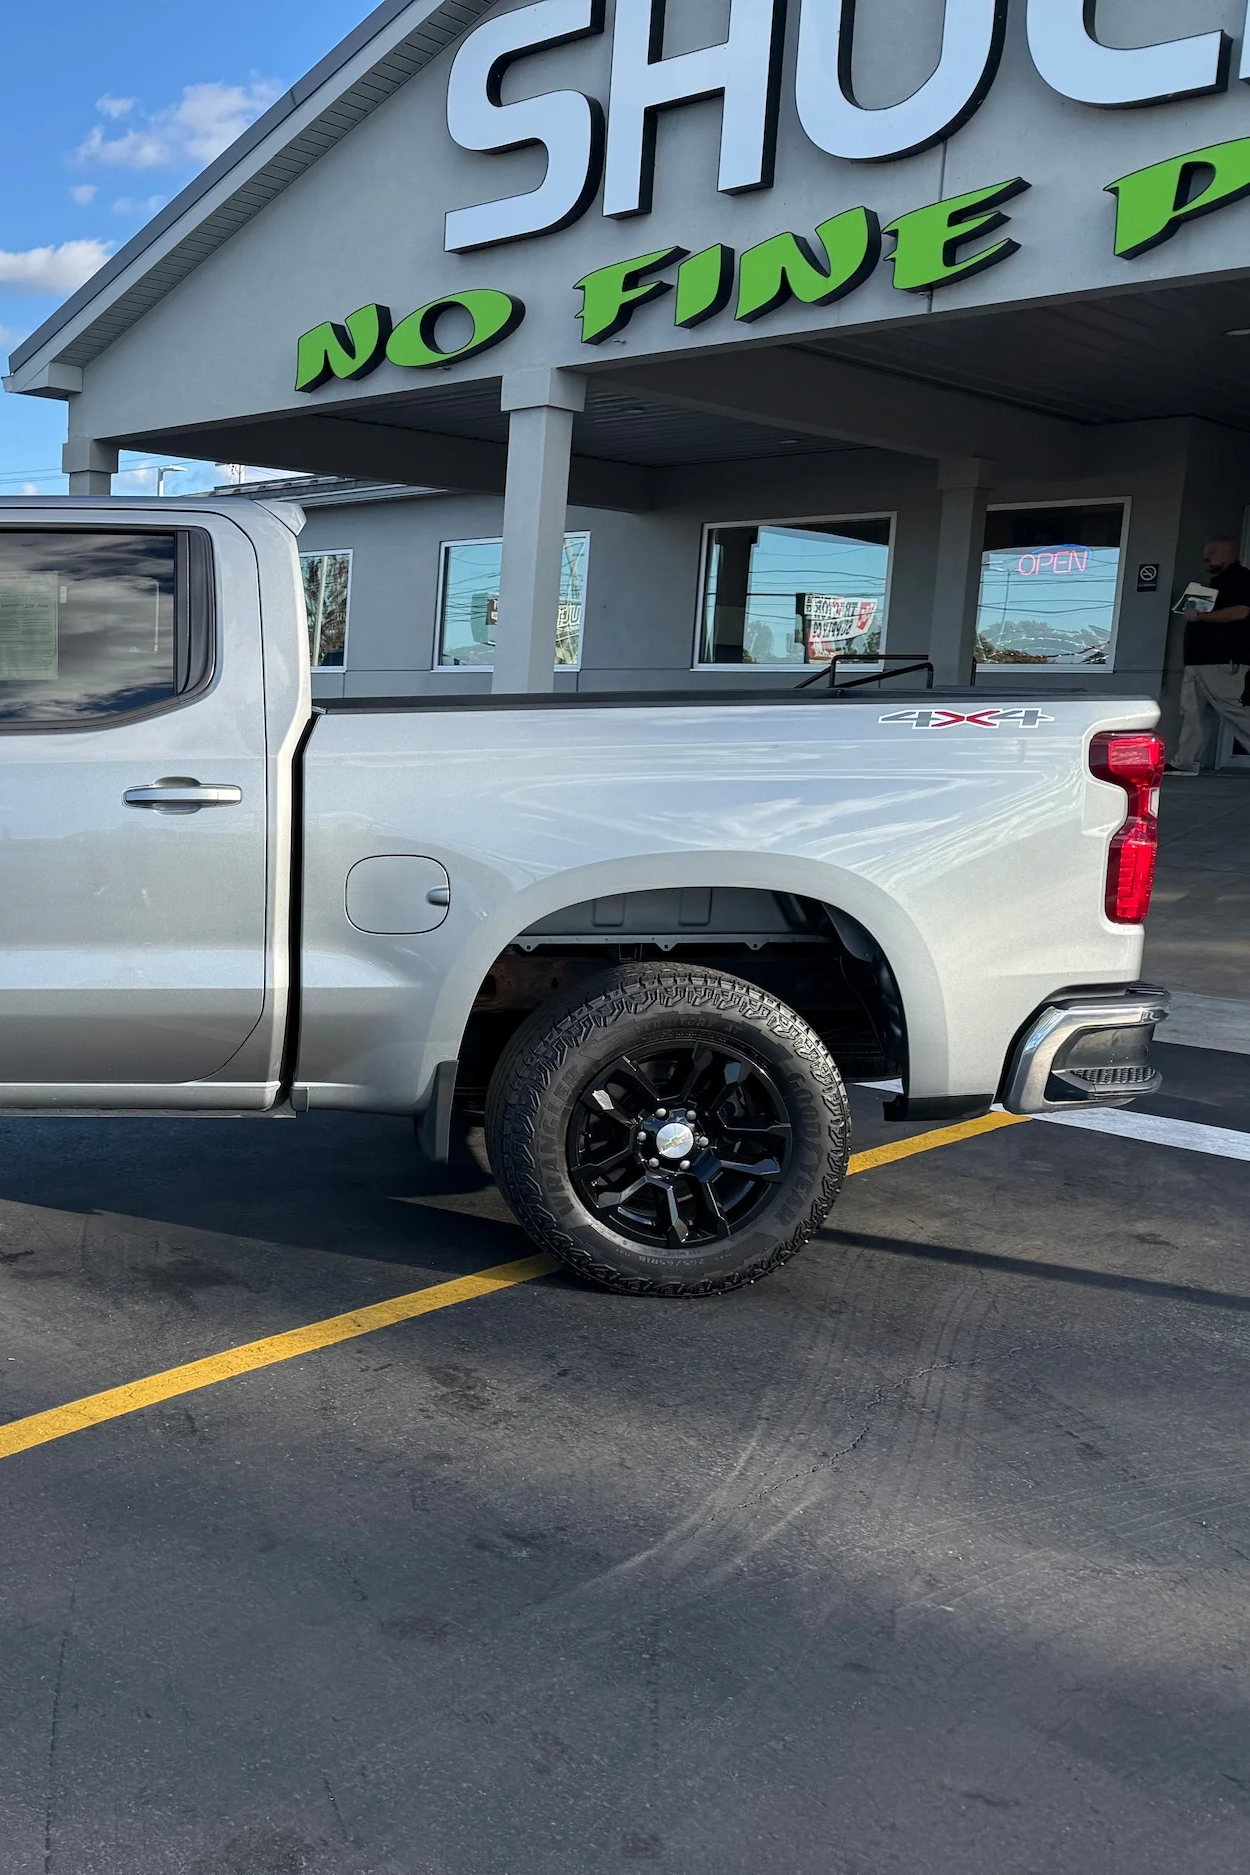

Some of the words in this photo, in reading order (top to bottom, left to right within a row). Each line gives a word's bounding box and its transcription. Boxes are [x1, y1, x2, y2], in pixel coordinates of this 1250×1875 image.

[294, 288, 526, 393] NO
[573, 177, 1032, 345] FINE
[1018, 550, 1088, 576] OPEN
